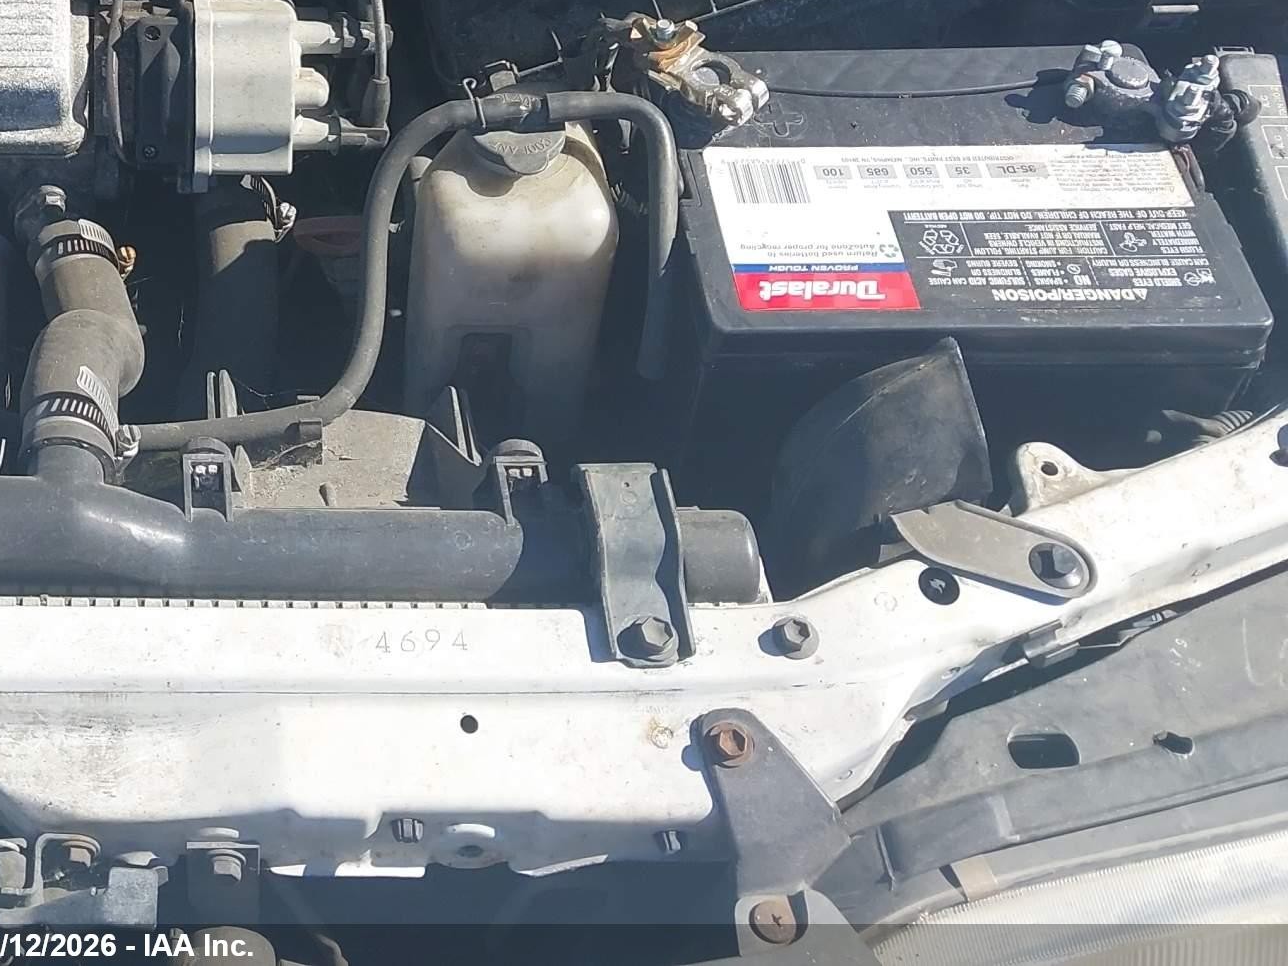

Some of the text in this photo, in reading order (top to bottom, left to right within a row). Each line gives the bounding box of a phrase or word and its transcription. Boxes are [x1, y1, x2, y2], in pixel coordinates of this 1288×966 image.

[822, 168, 844, 176] 100
[866, 168, 889, 176] 685
[910, 167, 933, 175] 550
[955, 167, 970, 175] 35
[997, 165, 1036, 174] 35-DL
[1073, 275, 1091, 285] NO
[759, 281, 886, 301] Duralast
[992, 289, 1136, 300] DANGER/POISON
[376, 628, 468, 653] 4694
